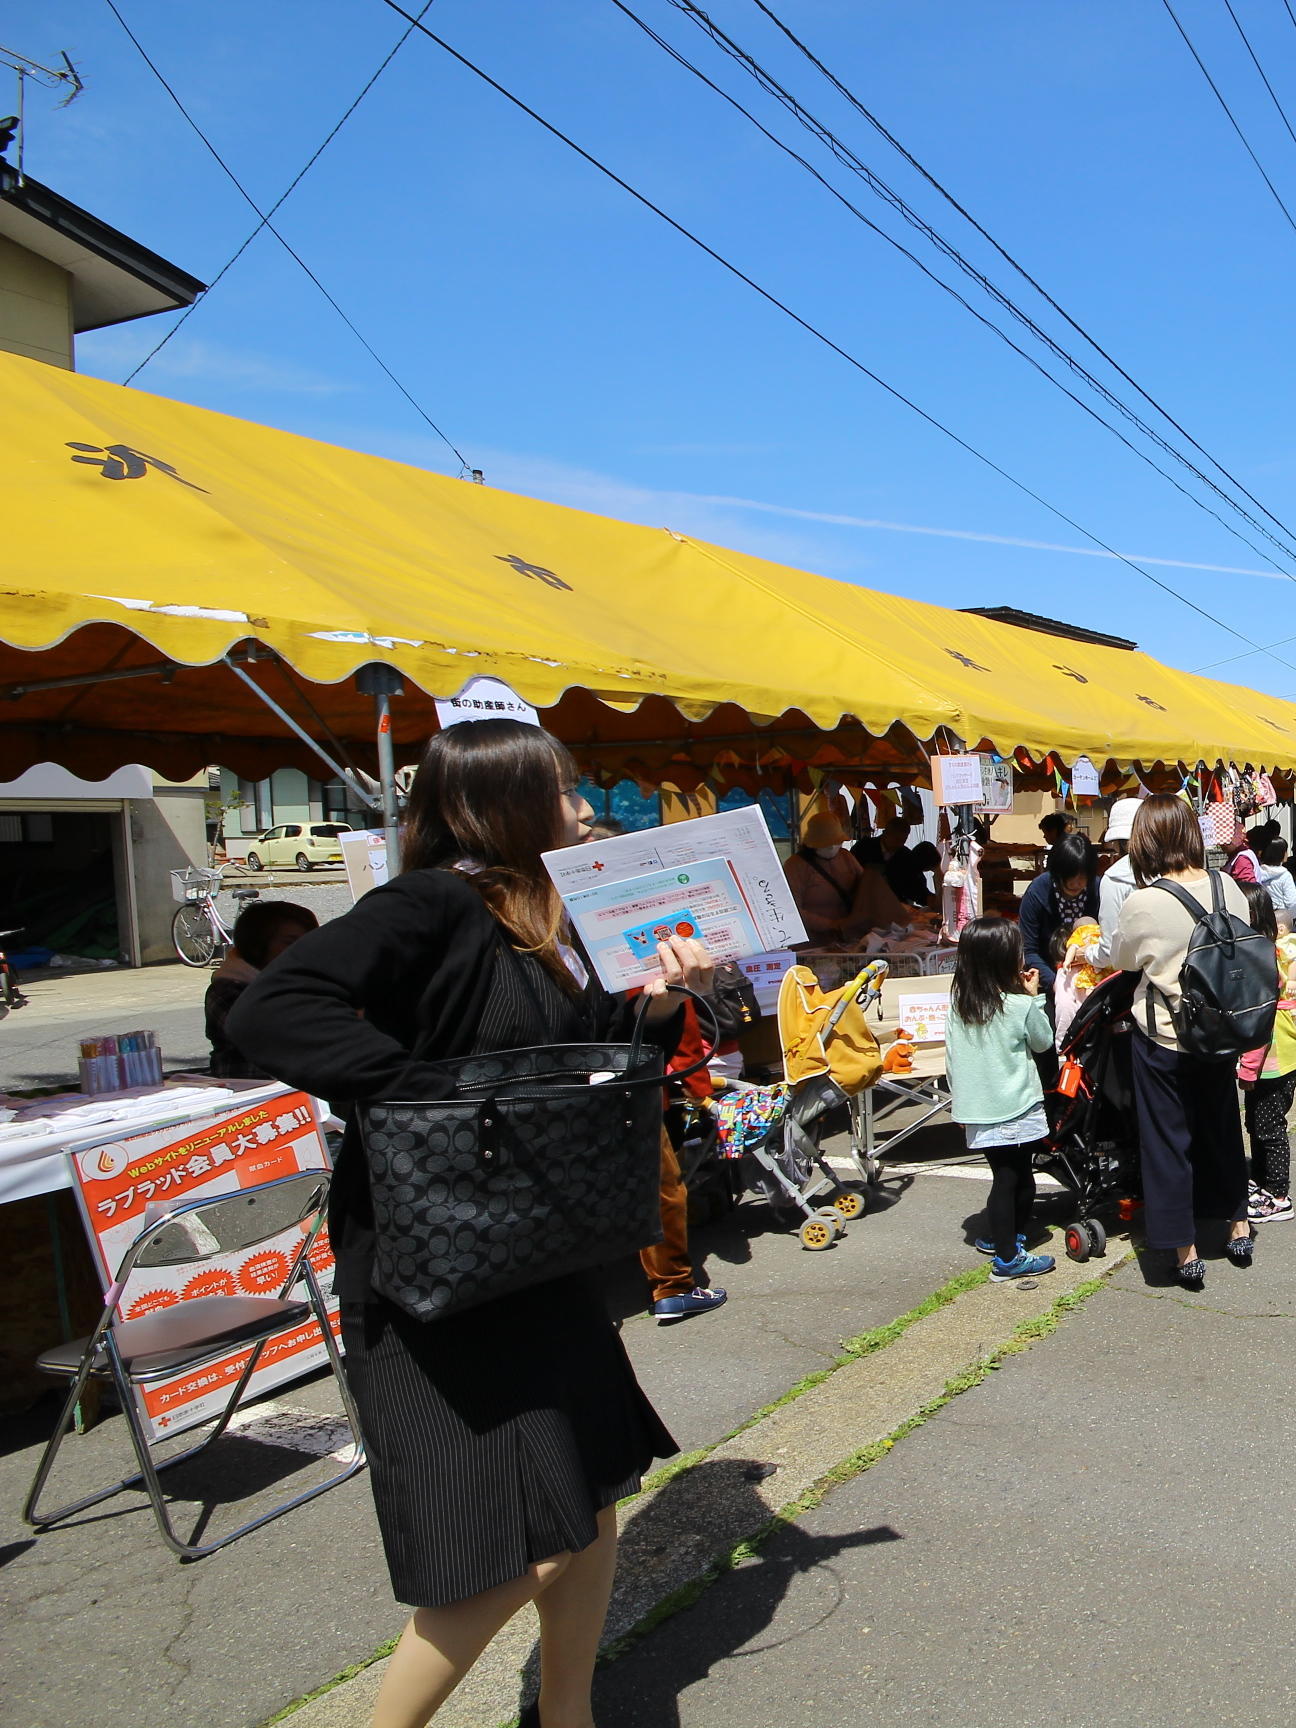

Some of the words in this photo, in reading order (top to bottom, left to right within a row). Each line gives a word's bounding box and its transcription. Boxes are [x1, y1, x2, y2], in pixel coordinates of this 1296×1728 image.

[450, 696, 527, 713] 街の助産師さん
[128, 1110, 270, 1179] Webサイトをリニューアルしました
[191, 1277, 227, 1297] ポイントが
